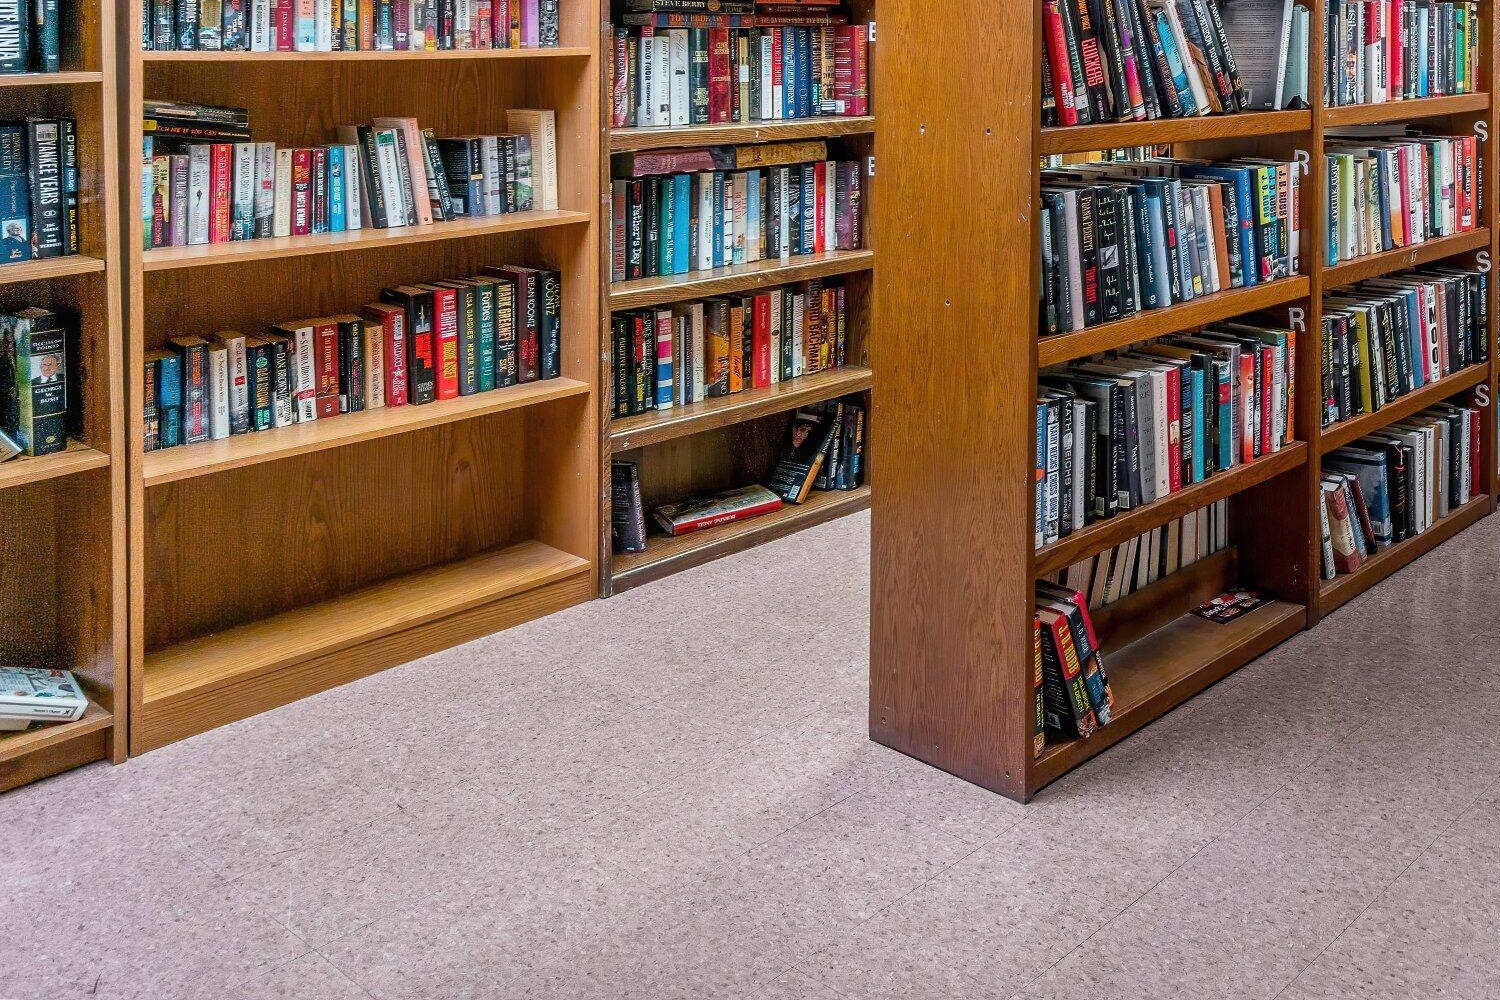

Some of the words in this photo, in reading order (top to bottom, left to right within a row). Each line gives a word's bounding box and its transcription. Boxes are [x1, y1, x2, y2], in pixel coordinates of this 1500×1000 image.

[186, 0, 197, 23] BROOKS
[655, 0, 681, 8] STEVE
[798, 30, 806, 48] DAN
[1135, 21, 1146, 47] CONNELLY
[1209, 2, 1222, 29] JAMES
[1217, 29, 1237, 73] PATTERSON
[1347, 12, 1356, 41] Silva
[0, 25, 19, 60] NINJA
[799, 50, 807, 80] BROWN
[1081, 38, 1104, 86] CLOCKERS
[1198, 17, 1214, 46] PATTERSON
[1209, 48, 1220, 72] DOUBLE
[1216, 72, 1229, 96] CROSS
[1474, 120, 1488, 141] S
[2, 133, 12, 170] KENNEDY
[38, 141, 59, 175] YANKEE
[66, 135, 75, 167] O'Reilly
[1294, 150, 1309, 175] R
[39, 176, 59, 205] YEARS
[239, 179, 249, 201] BROWN
[1229, 187, 1238, 214] SUSPECT
[1081, 196, 1092, 222] FRANK
[1279, 192, 1287, 217] ROBB
[616, 224, 624, 245] BROWN
[632, 204, 643, 247] Father's
[1082, 222, 1093, 252] PERETTI
[615, 247, 624, 274] SANDRA
[631, 249, 643, 265] Day
[1476, 251, 1491, 273] S
[527, 277, 535, 297] DEAN
[1085, 266, 1096, 283] THE
[482, 291, 492, 321] Forbes
[499, 284, 511, 307] MARK
[545, 278, 554, 316] KOONTZ
[808, 279, 820, 321] RICHARD
[1085, 284, 1097, 304] OATH
[441, 312, 457, 338] GRIFFIN
[498, 308, 511, 342] GREANEY
[527, 299, 535, 328] KOONTZ
[1288, 308, 1305, 331] R
[644, 319, 652, 337] ONCE
[300, 339, 309, 364] SANDRA
[644, 338, 653, 357] WERE
[808, 324, 821, 371] BACHMAN
[277, 353, 286, 368] DAN
[499, 359, 507, 371] SIX
[256, 369, 267, 382] DAN
[278, 369, 288, 392] BROWN
[256, 383, 267, 409] BROWN
[1475, 384, 1490, 407] S
[1050, 425, 1058, 445] KATHY
[1049, 446, 1058, 469] REICHS
[1049, 473, 1058, 495] CROSS
[1049, 496, 1058, 519] BONES
[1063, 648, 1080, 674] ROBB
[1072, 681, 1079, 690] IN
[1078, 676, 1091, 710] DELUSION
[1074, 691, 1084, 713] DEATH
